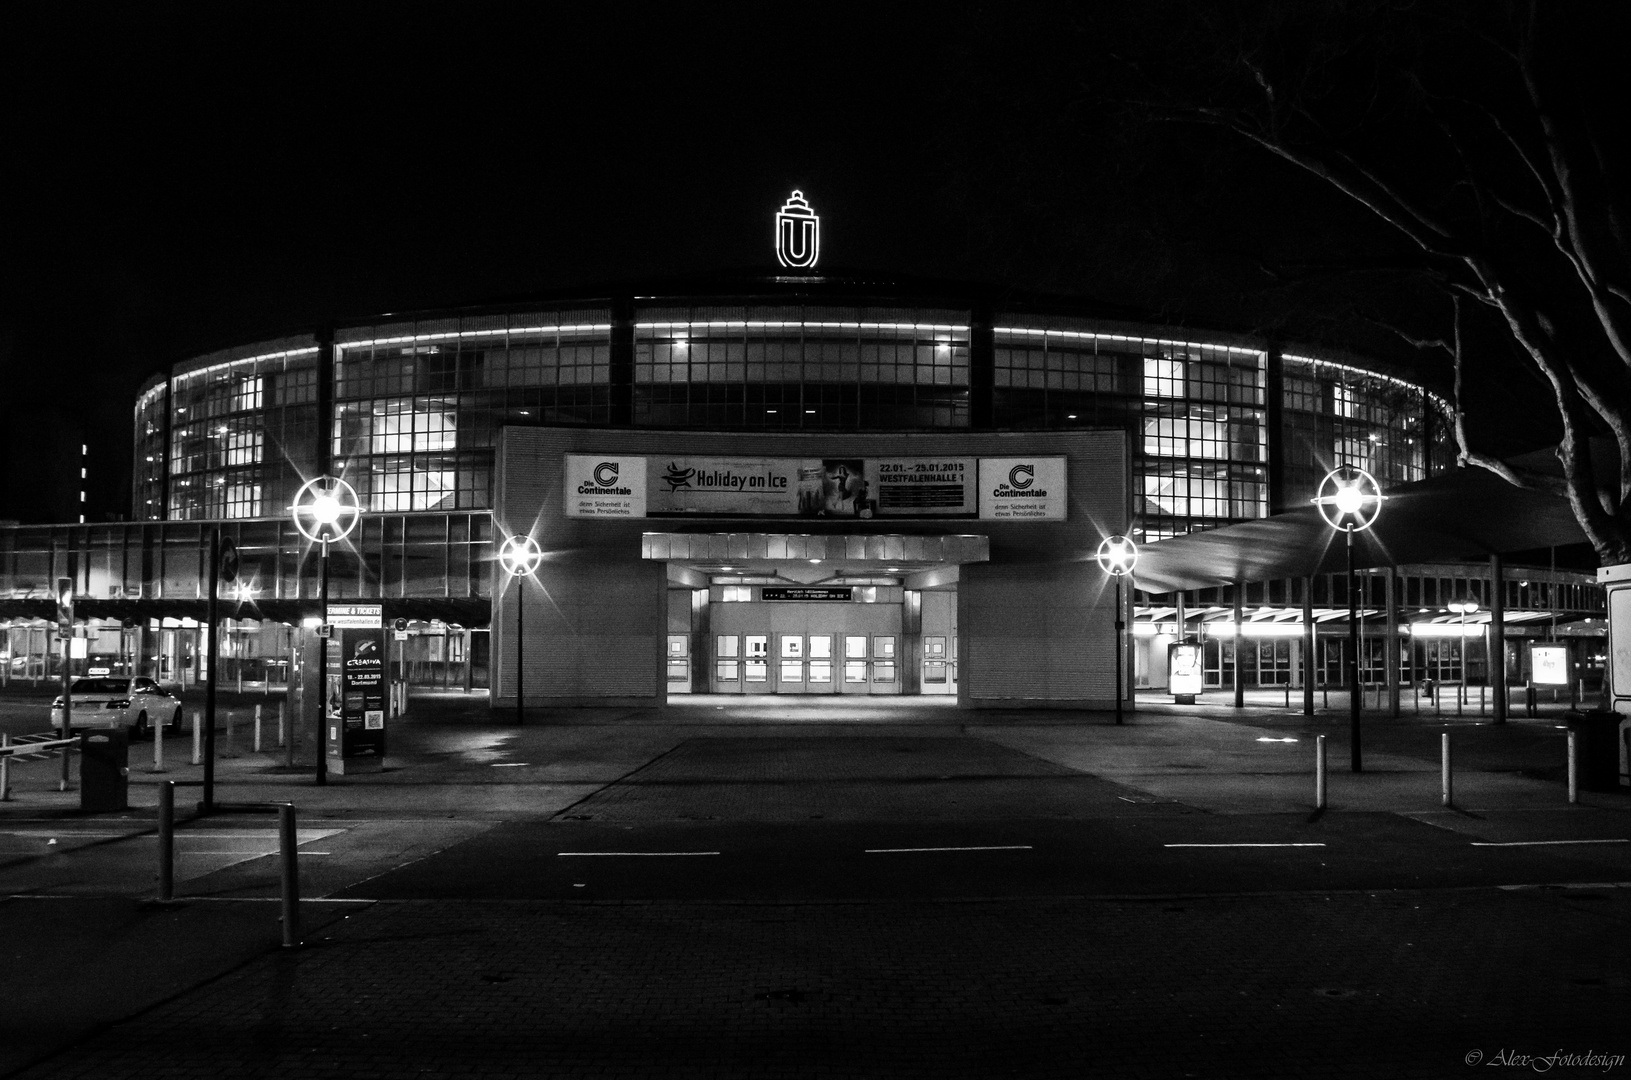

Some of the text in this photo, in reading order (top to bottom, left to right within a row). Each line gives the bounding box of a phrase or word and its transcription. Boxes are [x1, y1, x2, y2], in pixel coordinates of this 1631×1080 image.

[880, 464, 907, 473] 22.01.
[915, 463, 965, 473] 25.01.2015
[697, 470, 747, 491] Holiday
[749, 476, 765, 488] on
[768, 472, 787, 488] Ice
[880, 474, 964, 483] WESTFALENHALLE 1
[578, 487, 631, 495] Continentale
